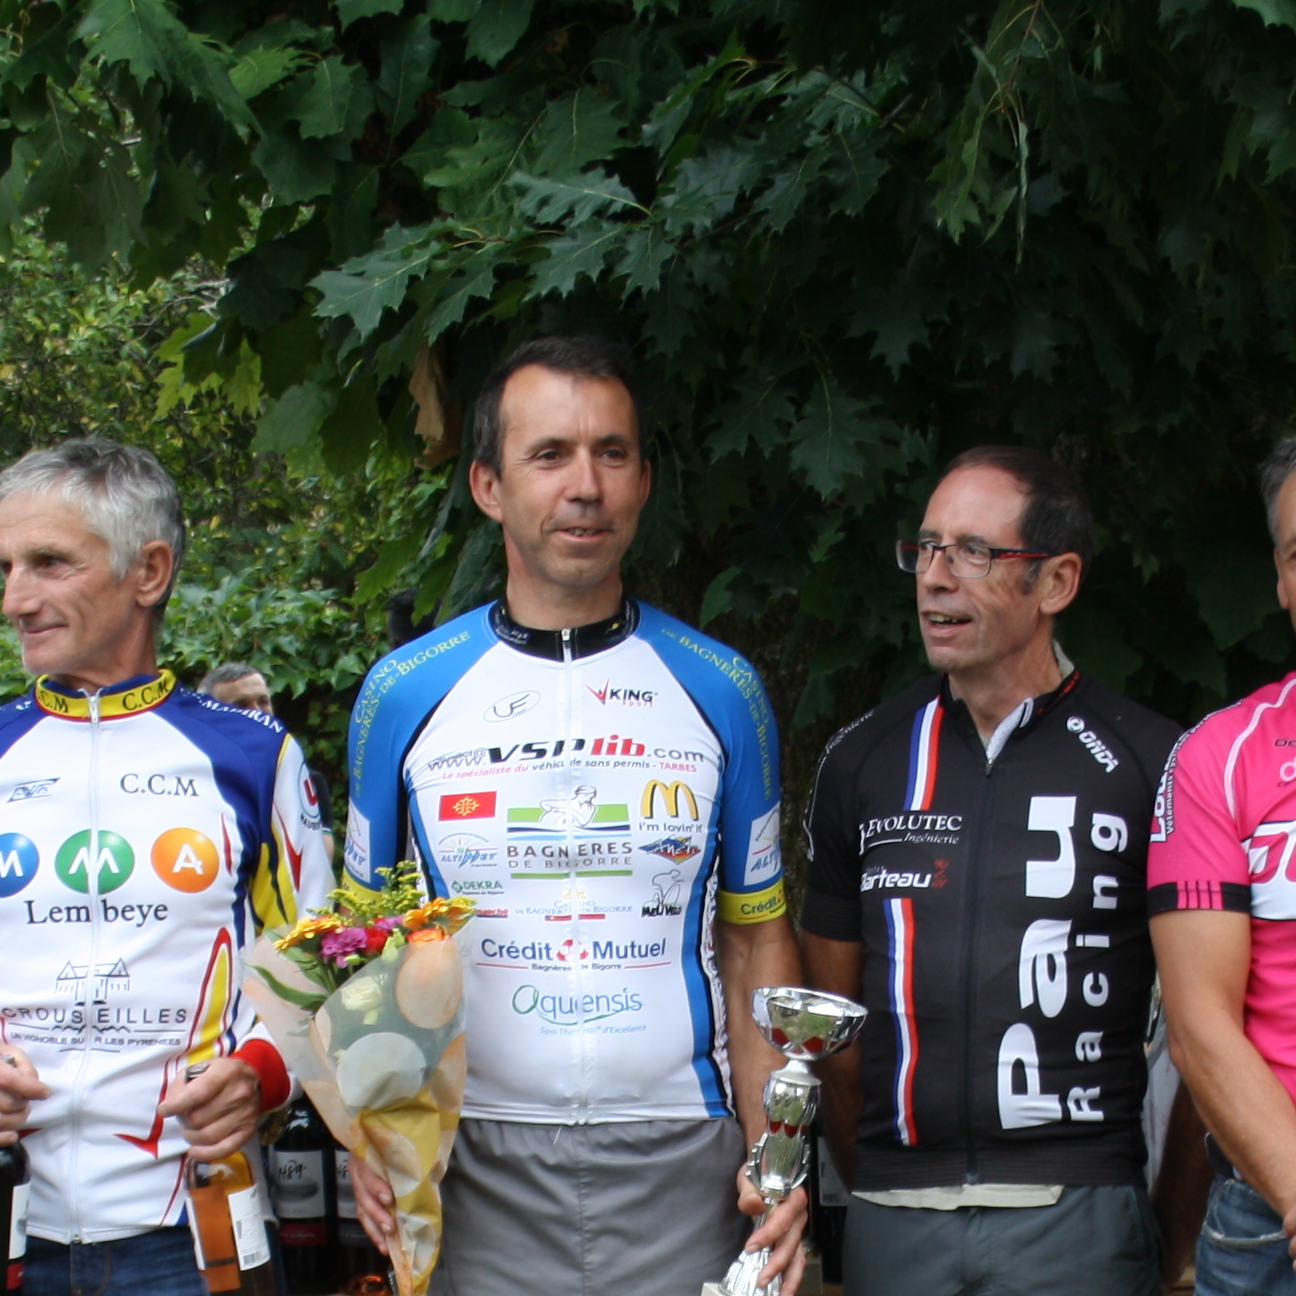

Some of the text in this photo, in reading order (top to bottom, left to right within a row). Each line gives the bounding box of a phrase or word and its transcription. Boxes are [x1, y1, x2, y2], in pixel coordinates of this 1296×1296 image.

[456, 766, 511, 779] spécialiste
[514, 764, 529, 773] du
[585, 760, 610, 768] sans
[613, 758, 650, 769] permis
[658, 761, 697, 773] TARBES
[119, 772, 200, 798] C.C.M
[639, 822, 659, 832] i'm
[507, 842, 634, 858] BAGNERES
[508, 860, 533, 869] DE
[463, 880, 503, 890] DEKRA
[24, 898, 169, 928] Lembeye
[480, 937, 667, 961] Crédit Mutuel
[997, 795, 1078, 1130] Pau
[1065, 812, 1129, 1122] Racing
[104, 1037, 125, 1046] LES
